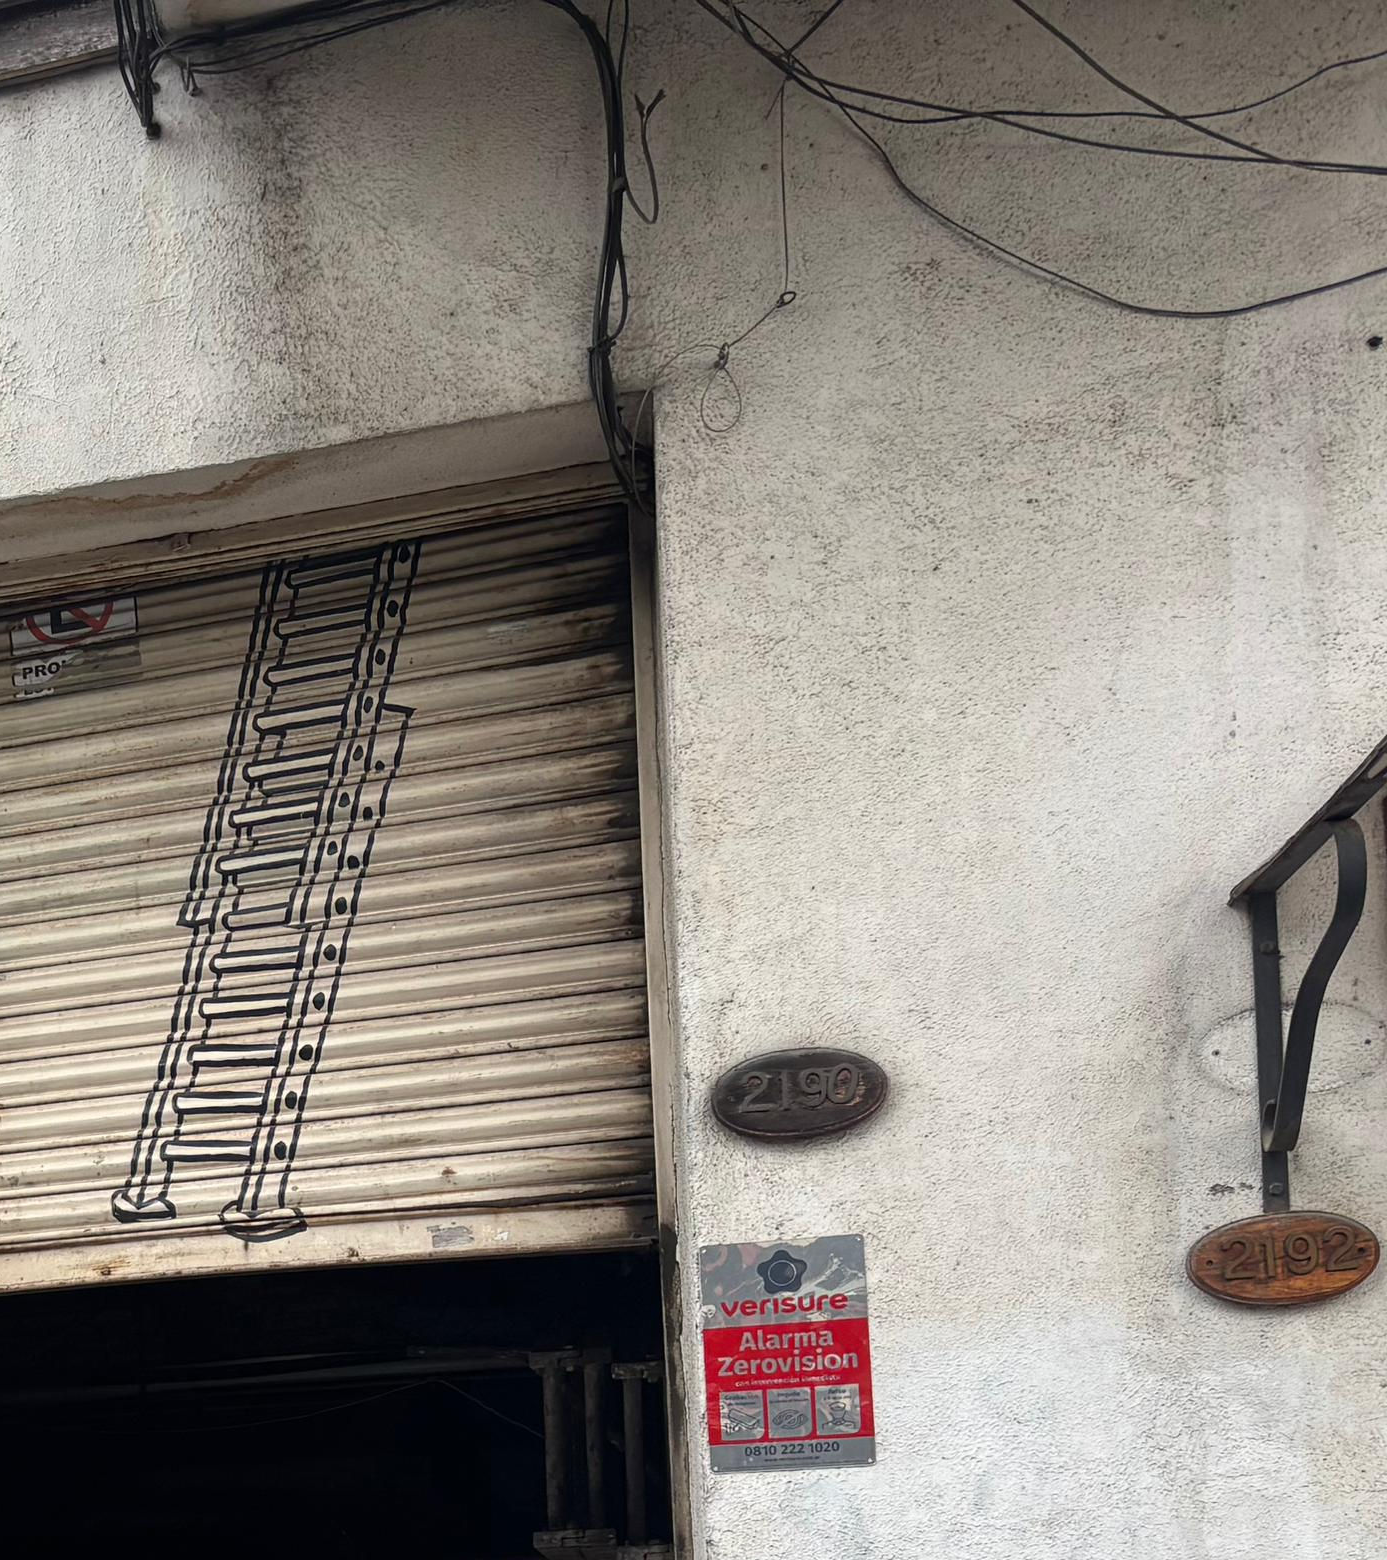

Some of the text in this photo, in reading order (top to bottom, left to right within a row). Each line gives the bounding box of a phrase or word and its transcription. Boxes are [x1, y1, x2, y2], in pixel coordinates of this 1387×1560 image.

[739, 1063, 858, 1113] 2190
[1221, 1226, 1358, 1281] 2192
[720, 1291, 849, 1317] verisure
[739, 1330, 834, 1351] Alarma
[718, 1348, 858, 1377] Zerovision
[744, 1441, 840, 1457] 0810 222 1020
